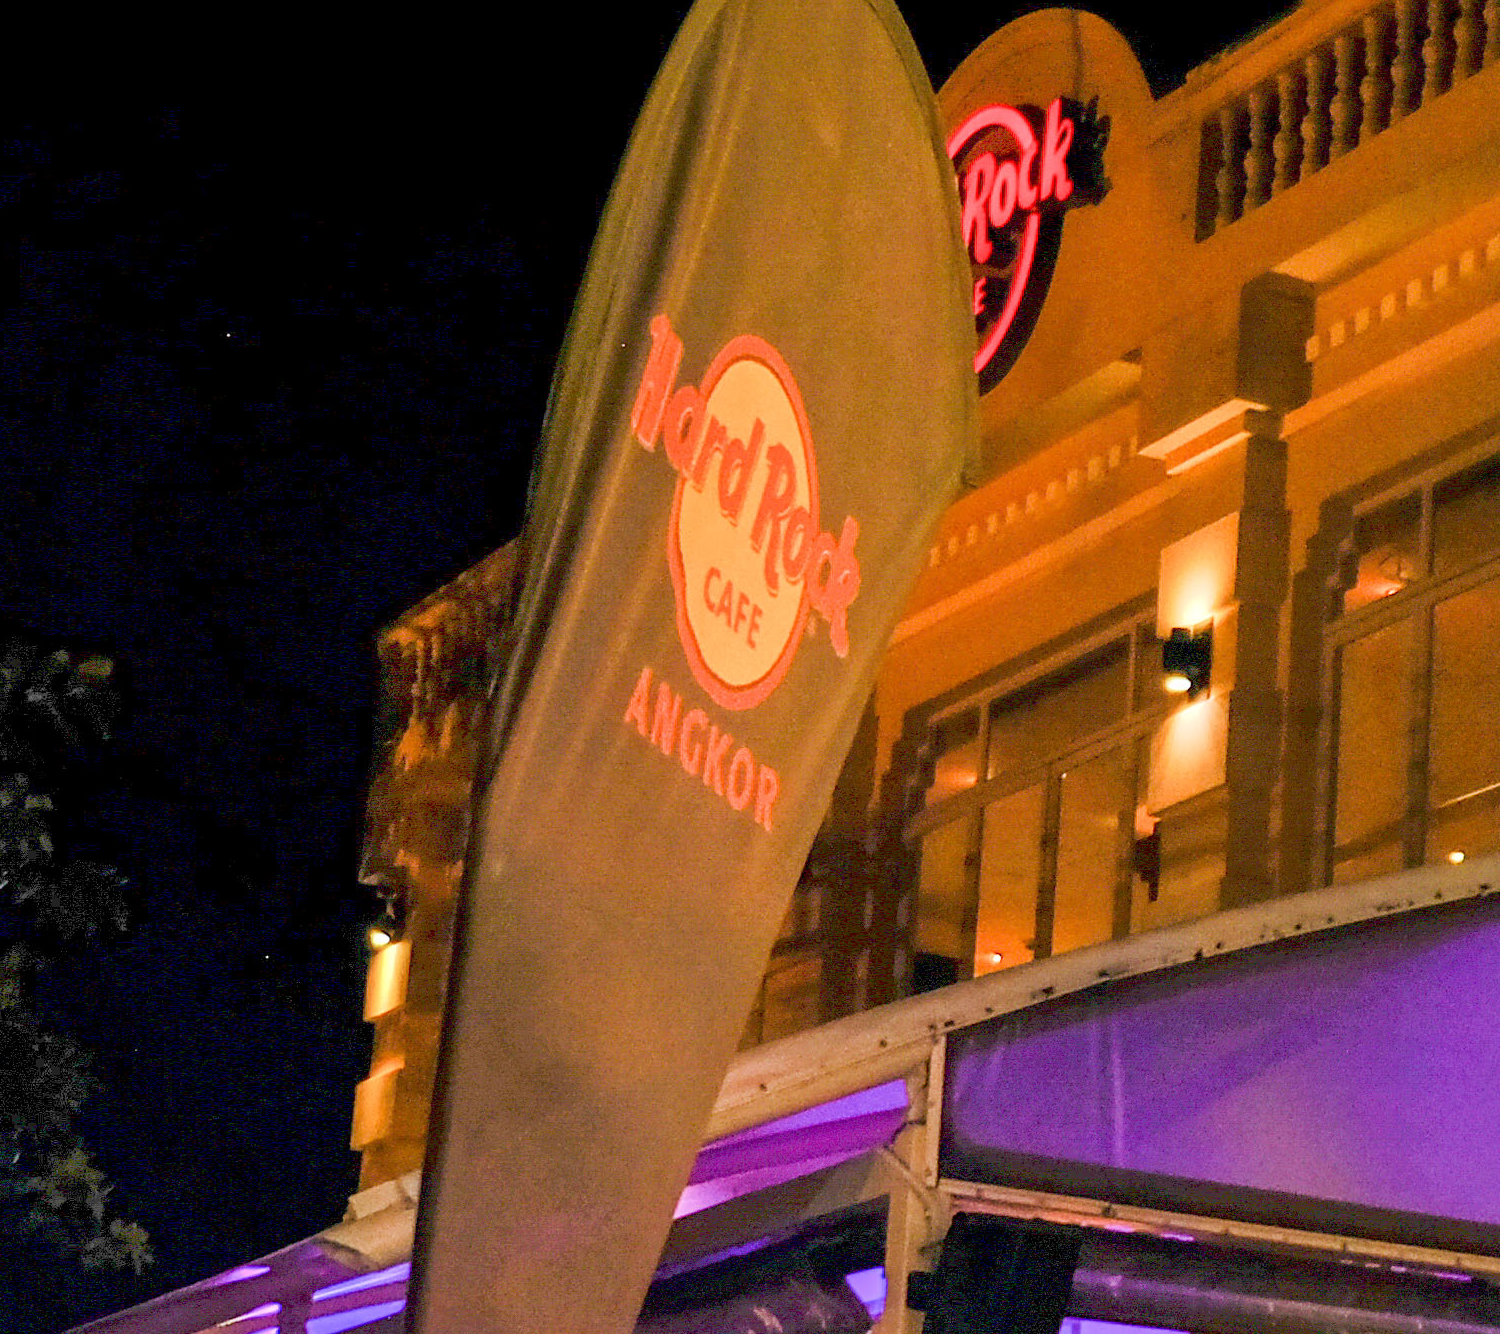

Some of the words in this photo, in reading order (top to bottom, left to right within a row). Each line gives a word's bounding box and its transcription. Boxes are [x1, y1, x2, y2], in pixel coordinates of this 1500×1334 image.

[960, 96, 1075, 265] Rock
[702, 566, 764, 650] CAFE
[750, 443, 861, 658] Rock
[624, 667, 782, 831] ANGKOR
